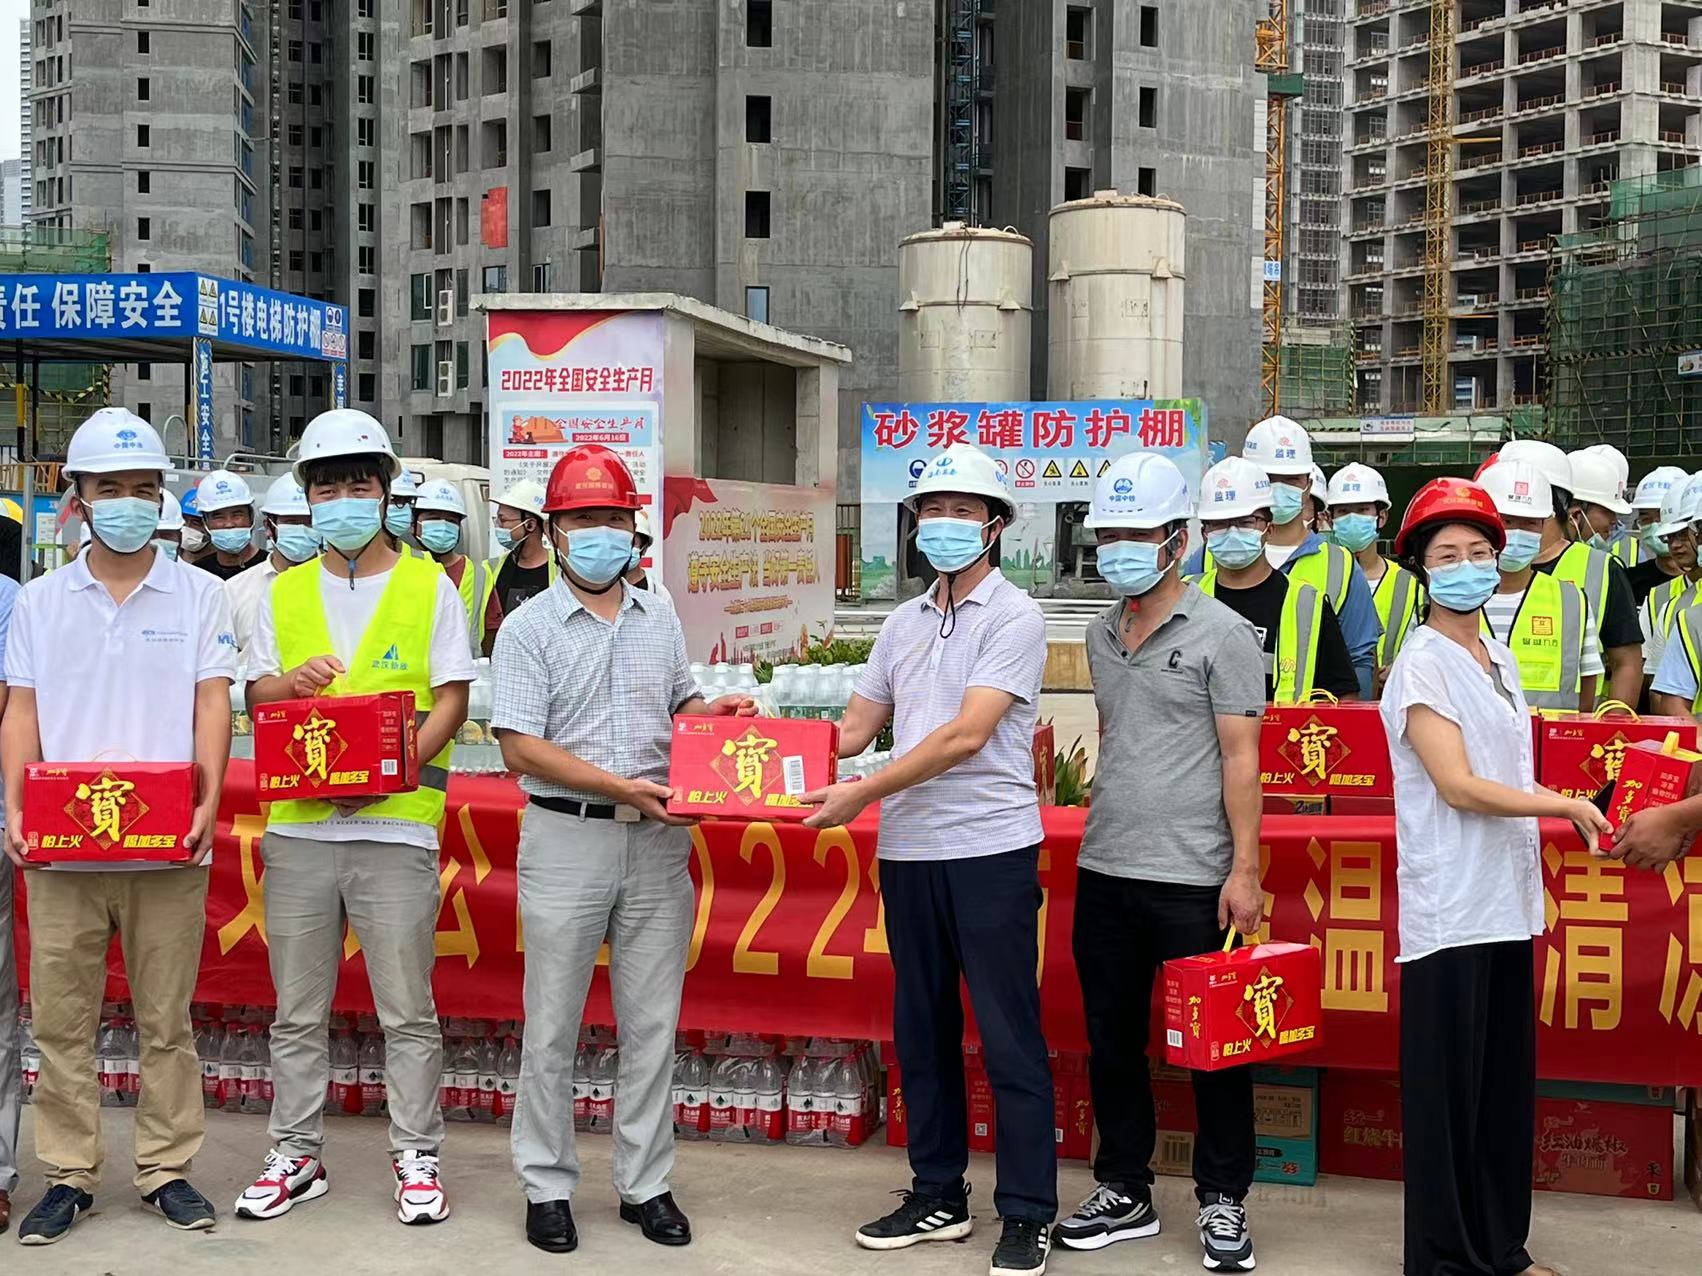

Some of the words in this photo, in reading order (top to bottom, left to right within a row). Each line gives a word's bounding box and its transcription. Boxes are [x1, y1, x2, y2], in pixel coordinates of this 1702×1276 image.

[0, 284, 41, 330] 任
[51, 280, 182, 329] 保障安全
[501, 367, 653, 392] 2022年全国安全生产月
[873, 409, 1185, 448] 砂浆罐防护棚
[1275, 448, 1296, 459] 监理
[1214, 490, 1236, 501] 监理
[269, 774, 300, 789] 怕上火
[329, 770, 370, 785] 喝加多宝
[1329, 773, 1376, 786] 喝加多宝
[687, 790, 728, 804] 怕上火
[41, 834, 83, 849] 怕上火
[123, 834, 177, 848] 喝加多宝
[1222, 1039, 1252, 1057] 怕上火
[1278, 1025, 1316, 1045] 喝加多宝
